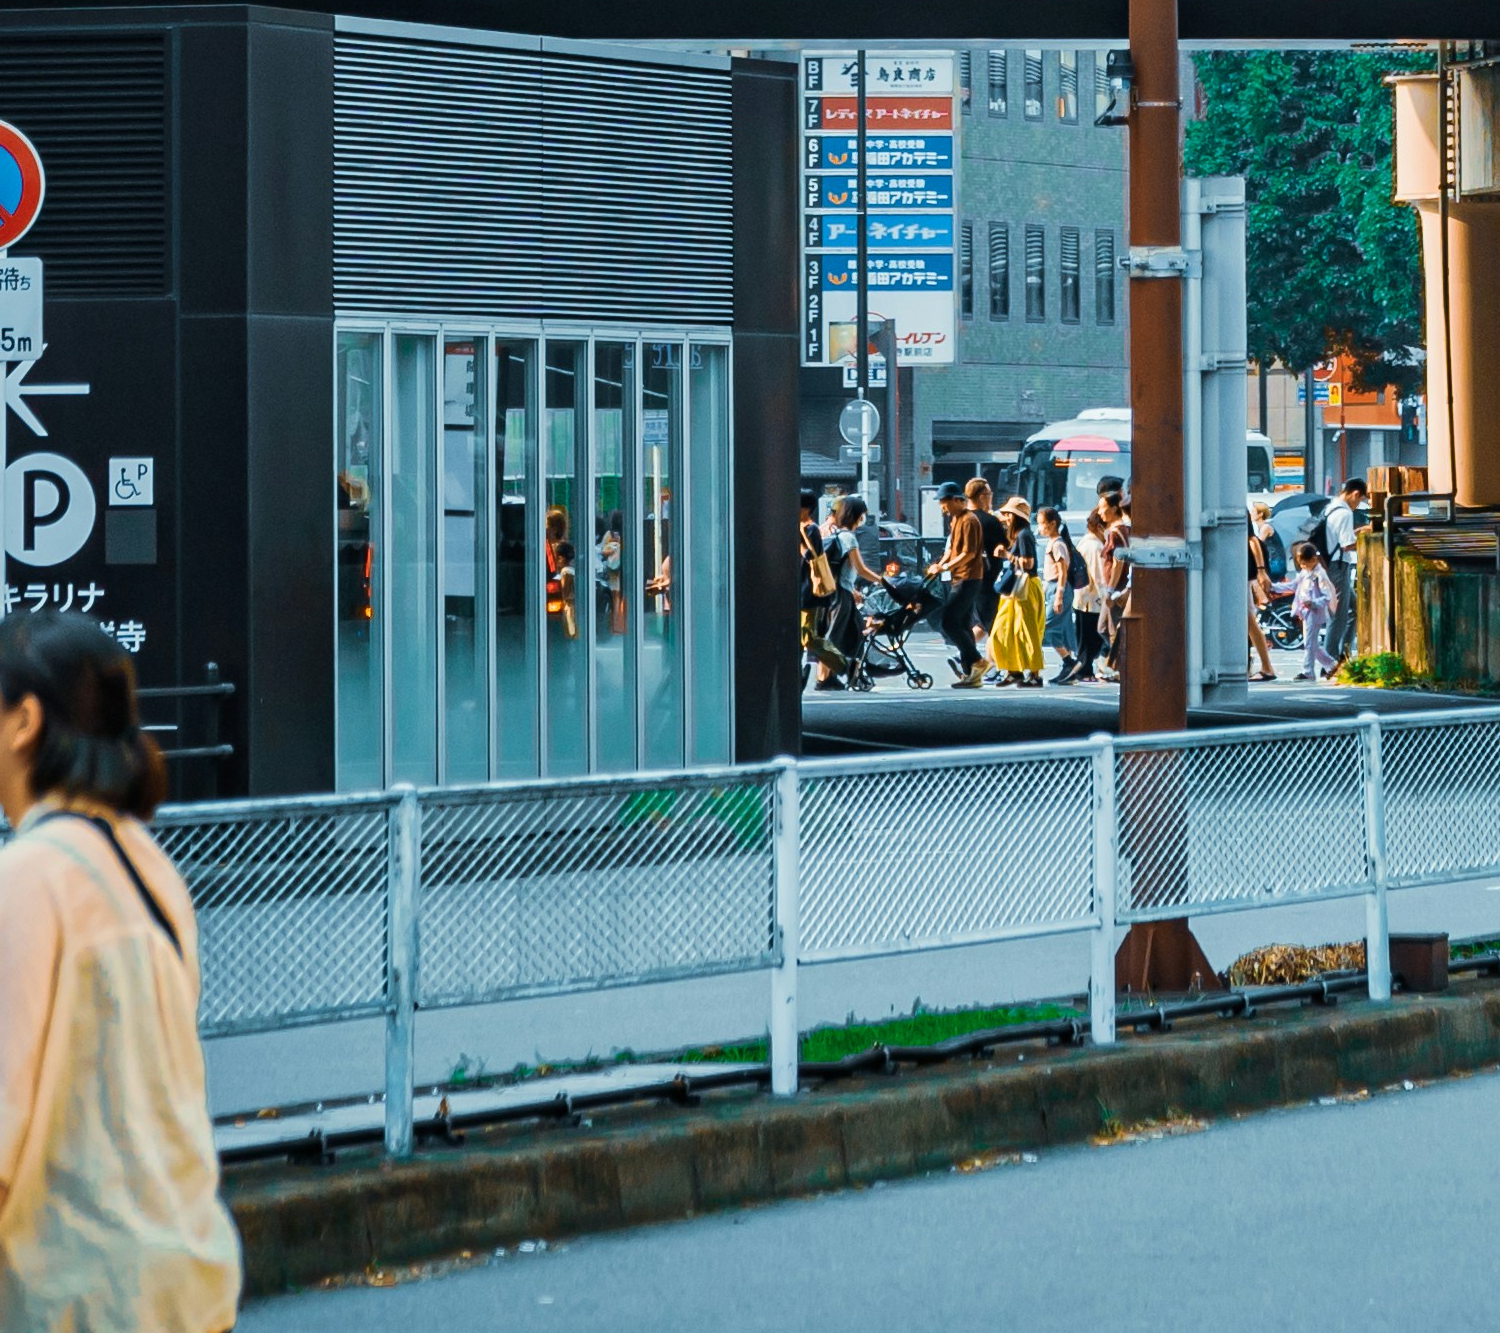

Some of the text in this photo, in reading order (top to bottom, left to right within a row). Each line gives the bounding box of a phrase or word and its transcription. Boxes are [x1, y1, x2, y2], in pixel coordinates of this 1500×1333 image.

[827, 222, 949, 240] アーネイチャー
